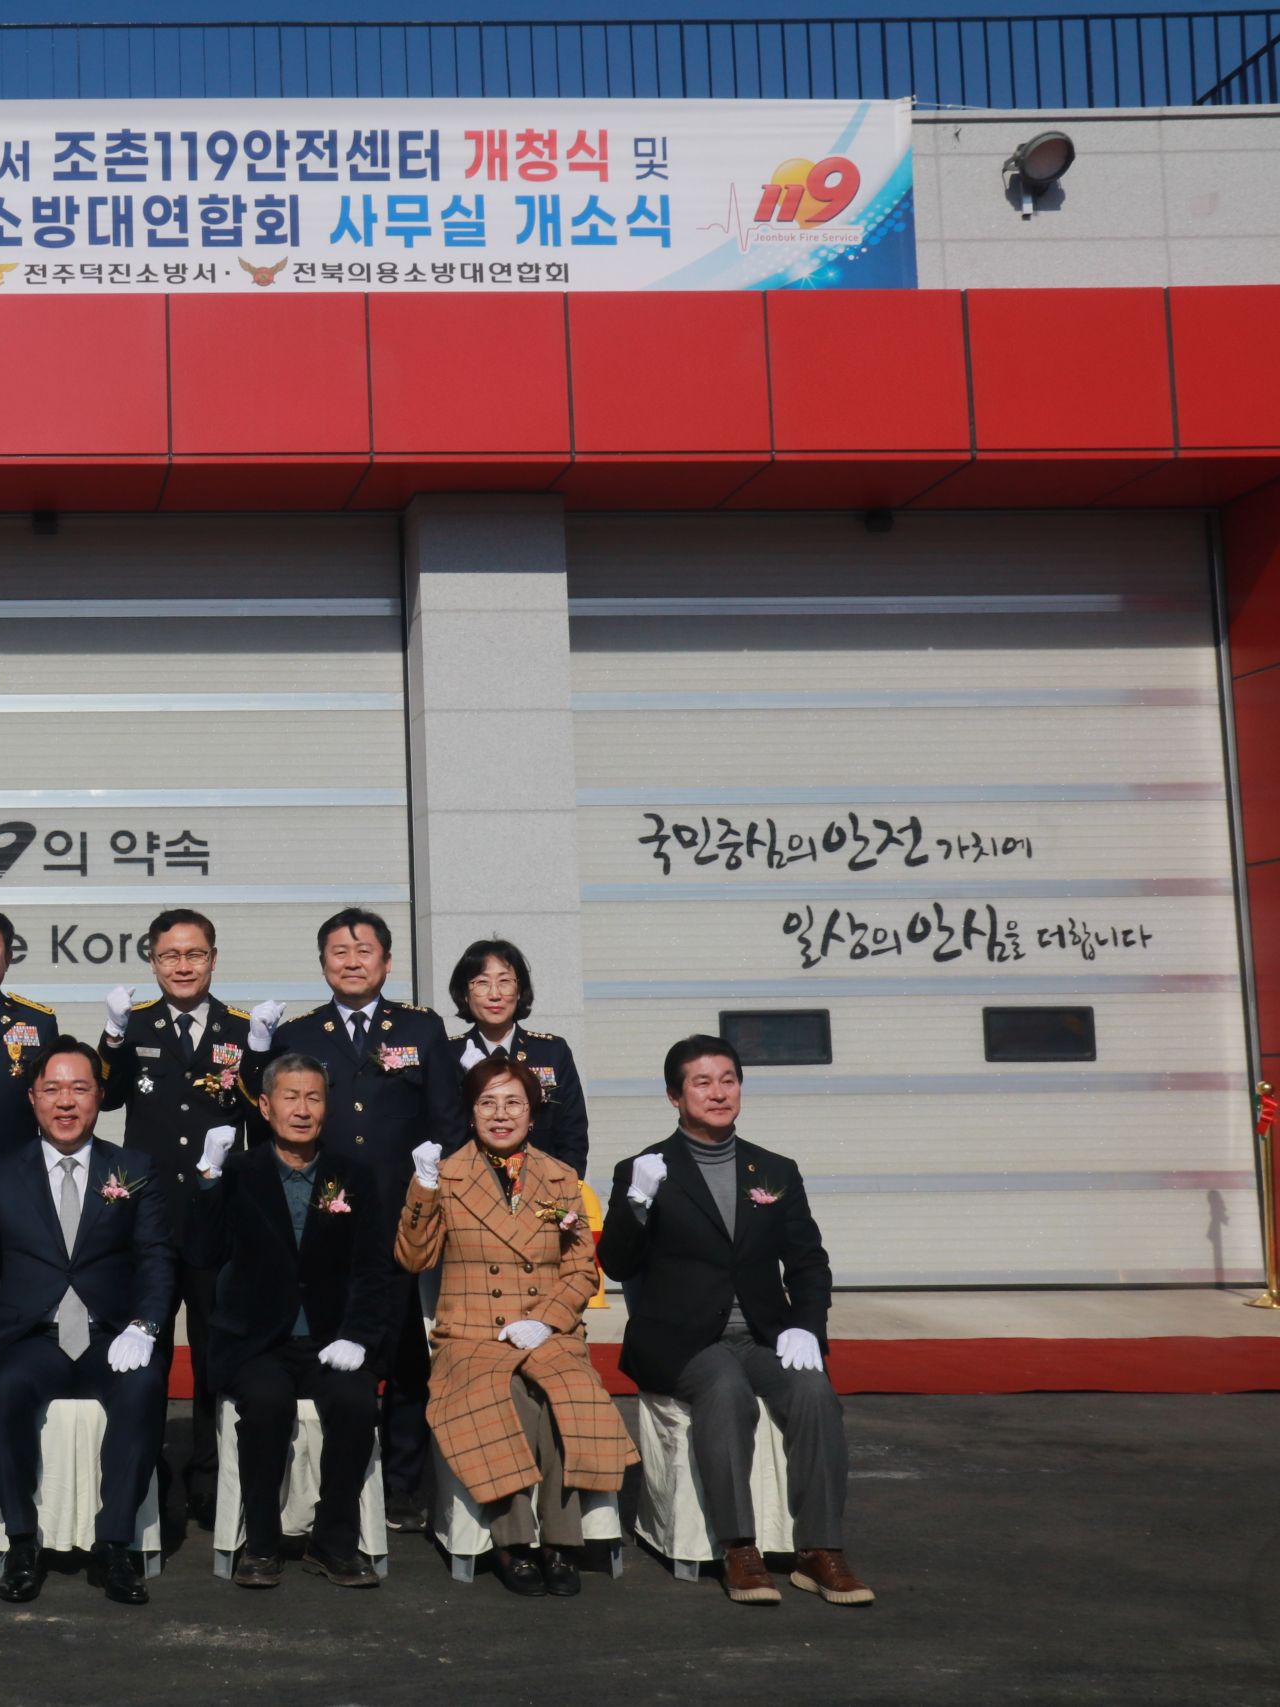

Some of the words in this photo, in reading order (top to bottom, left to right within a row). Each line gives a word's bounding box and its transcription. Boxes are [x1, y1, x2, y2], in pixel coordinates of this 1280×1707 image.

[53, 128, 440, 182] 조촌119안전센터
[464, 128, 609, 182] 개청식
[633, 136, 669, 181] 및
[753, 156, 861, 223] 119
[330, 194, 487, 249] 사무실
[515, 194, 671, 248] 개소식
[754, 232, 796, 242] Jeonbuk
[799, 232, 819, 242] Fire
[822, 232, 860, 242] Service
[293, 262, 570, 284] 전북의용소방대연합회
[110, 830, 210, 877] 약속
[638, 812, 818, 875] 국민중심의
[822, 812, 929, 871] 안전
[936, 832, 1033, 862] 가치에
[782, 905, 902, 969] 일상의
[1037, 918, 1153, 961] 더합니다
